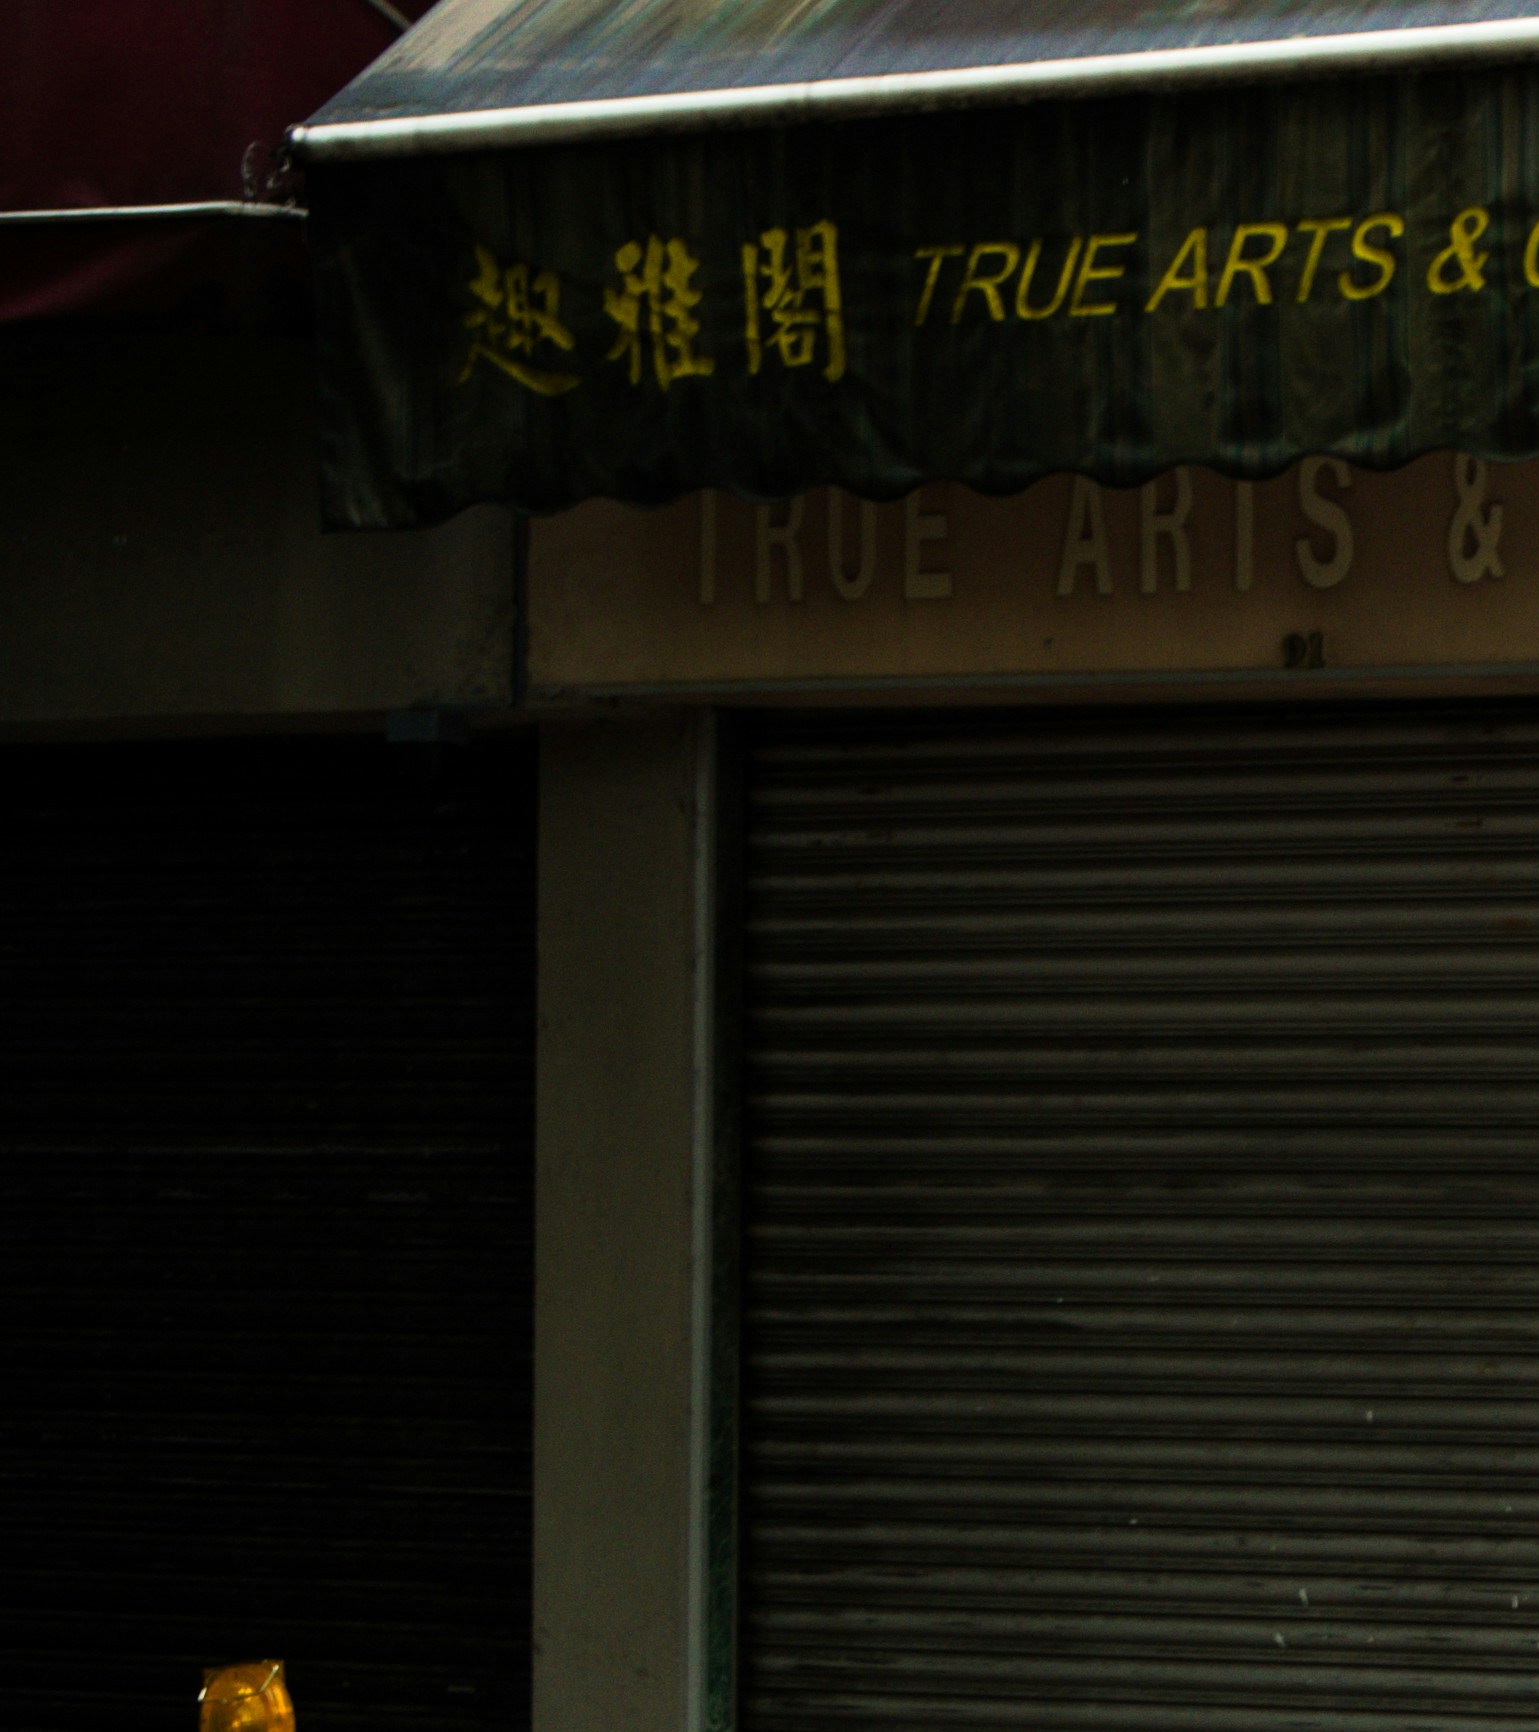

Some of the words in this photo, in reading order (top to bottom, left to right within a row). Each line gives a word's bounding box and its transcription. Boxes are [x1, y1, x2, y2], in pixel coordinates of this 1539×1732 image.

[914, 233, 1137, 324] TRUE
[1144, 212, 1403, 313] ARTS
[1424, 207, 1489, 294] &
